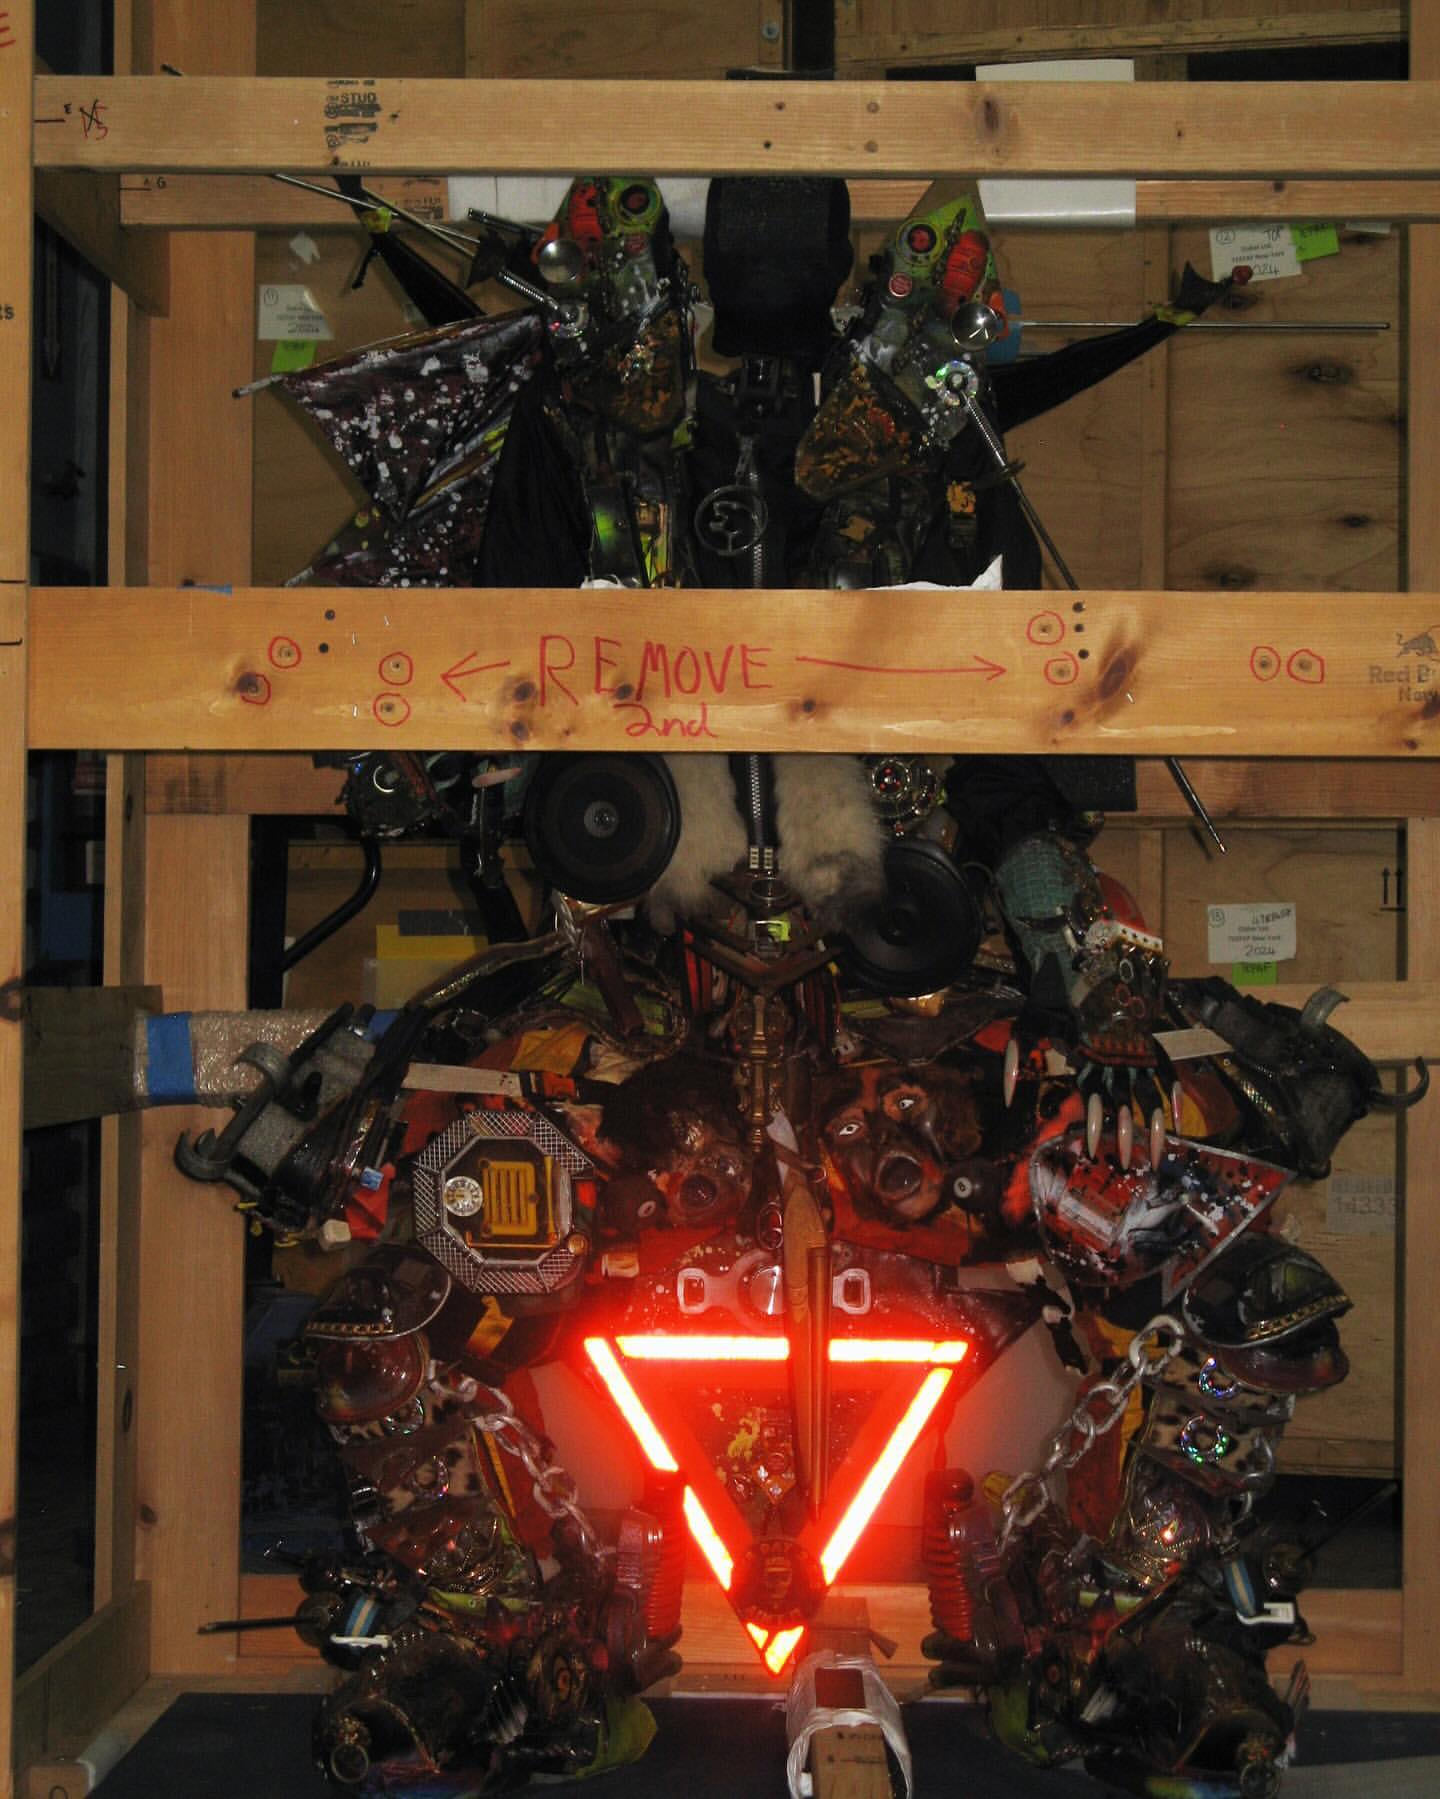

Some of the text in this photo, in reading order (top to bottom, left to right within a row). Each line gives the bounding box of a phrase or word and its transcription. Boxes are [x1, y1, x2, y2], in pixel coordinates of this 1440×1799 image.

[341, 92, 377, 104] STUD
[539, 635, 772, 706] REMOVE
[1369, 664, 1410, 684] Red
[624, 702, 719, 740] 2nd
